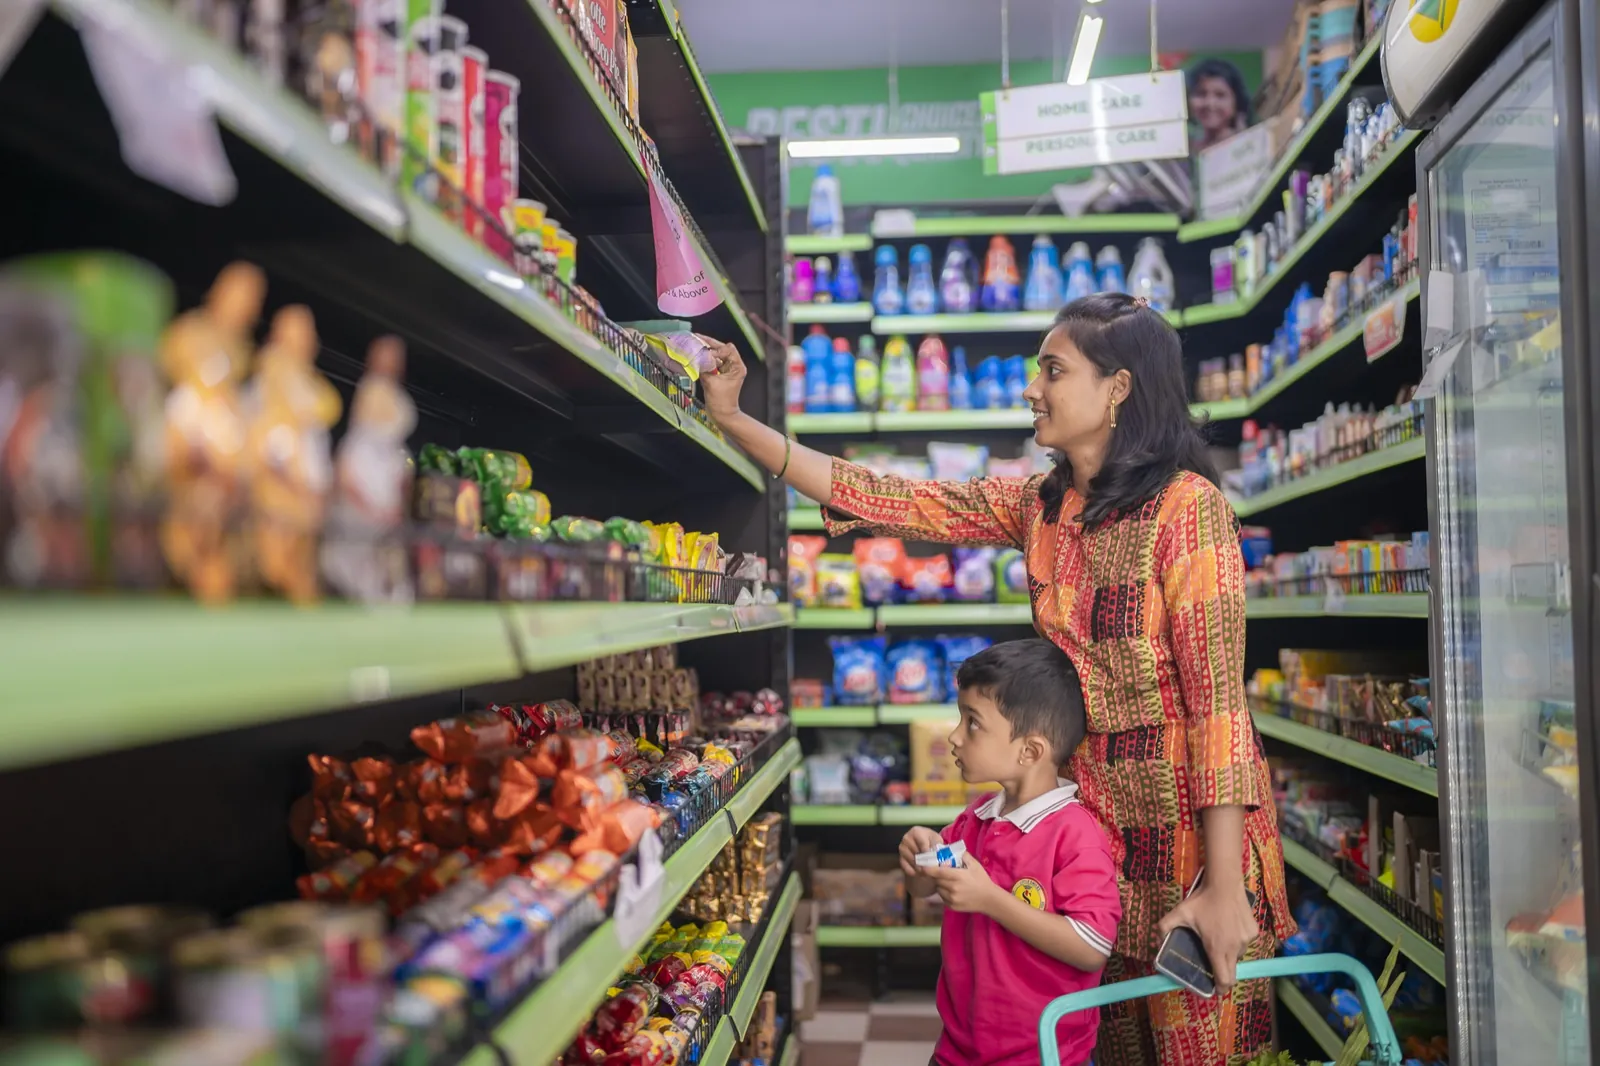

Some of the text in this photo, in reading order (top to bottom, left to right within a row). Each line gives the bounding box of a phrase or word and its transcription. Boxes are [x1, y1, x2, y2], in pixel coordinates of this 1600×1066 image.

[1037, 94, 1143, 118] HOME CARE
[1025, 129, 1157, 153] PERSON CARE
[693, 270, 705, 283] of
[678, 285, 708, 298] Above
